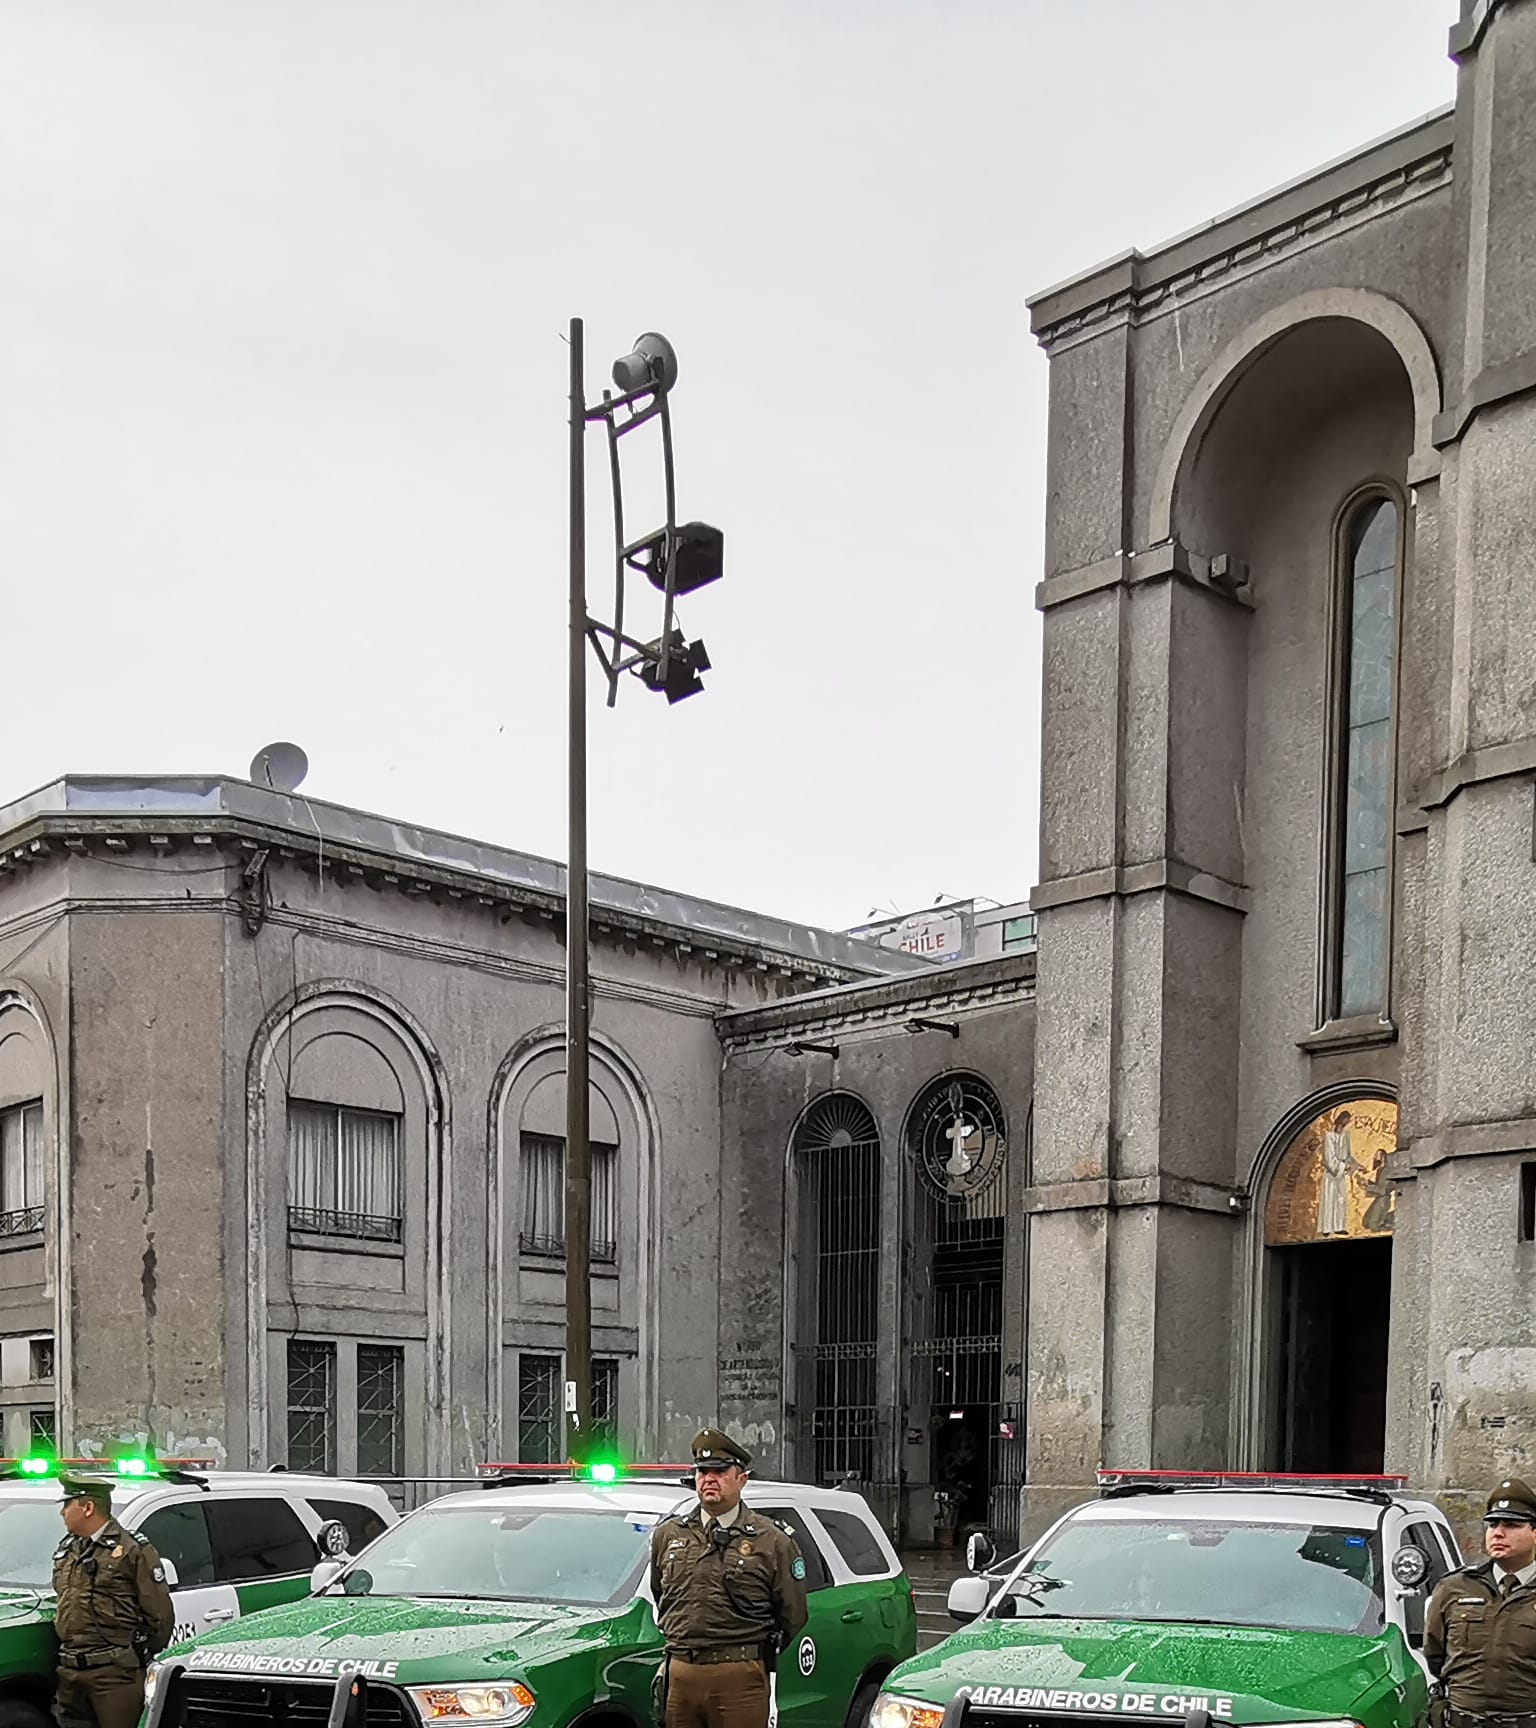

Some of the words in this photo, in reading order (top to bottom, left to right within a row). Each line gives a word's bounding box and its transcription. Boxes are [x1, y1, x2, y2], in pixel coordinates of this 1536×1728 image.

[898, 933, 945, 953] CHILE
[189, 1651, 308, 1673] CARABINEROS
[306, 1658, 338, 1674] DE
[337, 1659, 400, 1678] CHILE
[954, 1685, 1118, 1712] CARABINEROS
[1120, 1693, 1156, 1711] DE
[1159, 1695, 1233, 1716] CHILE
